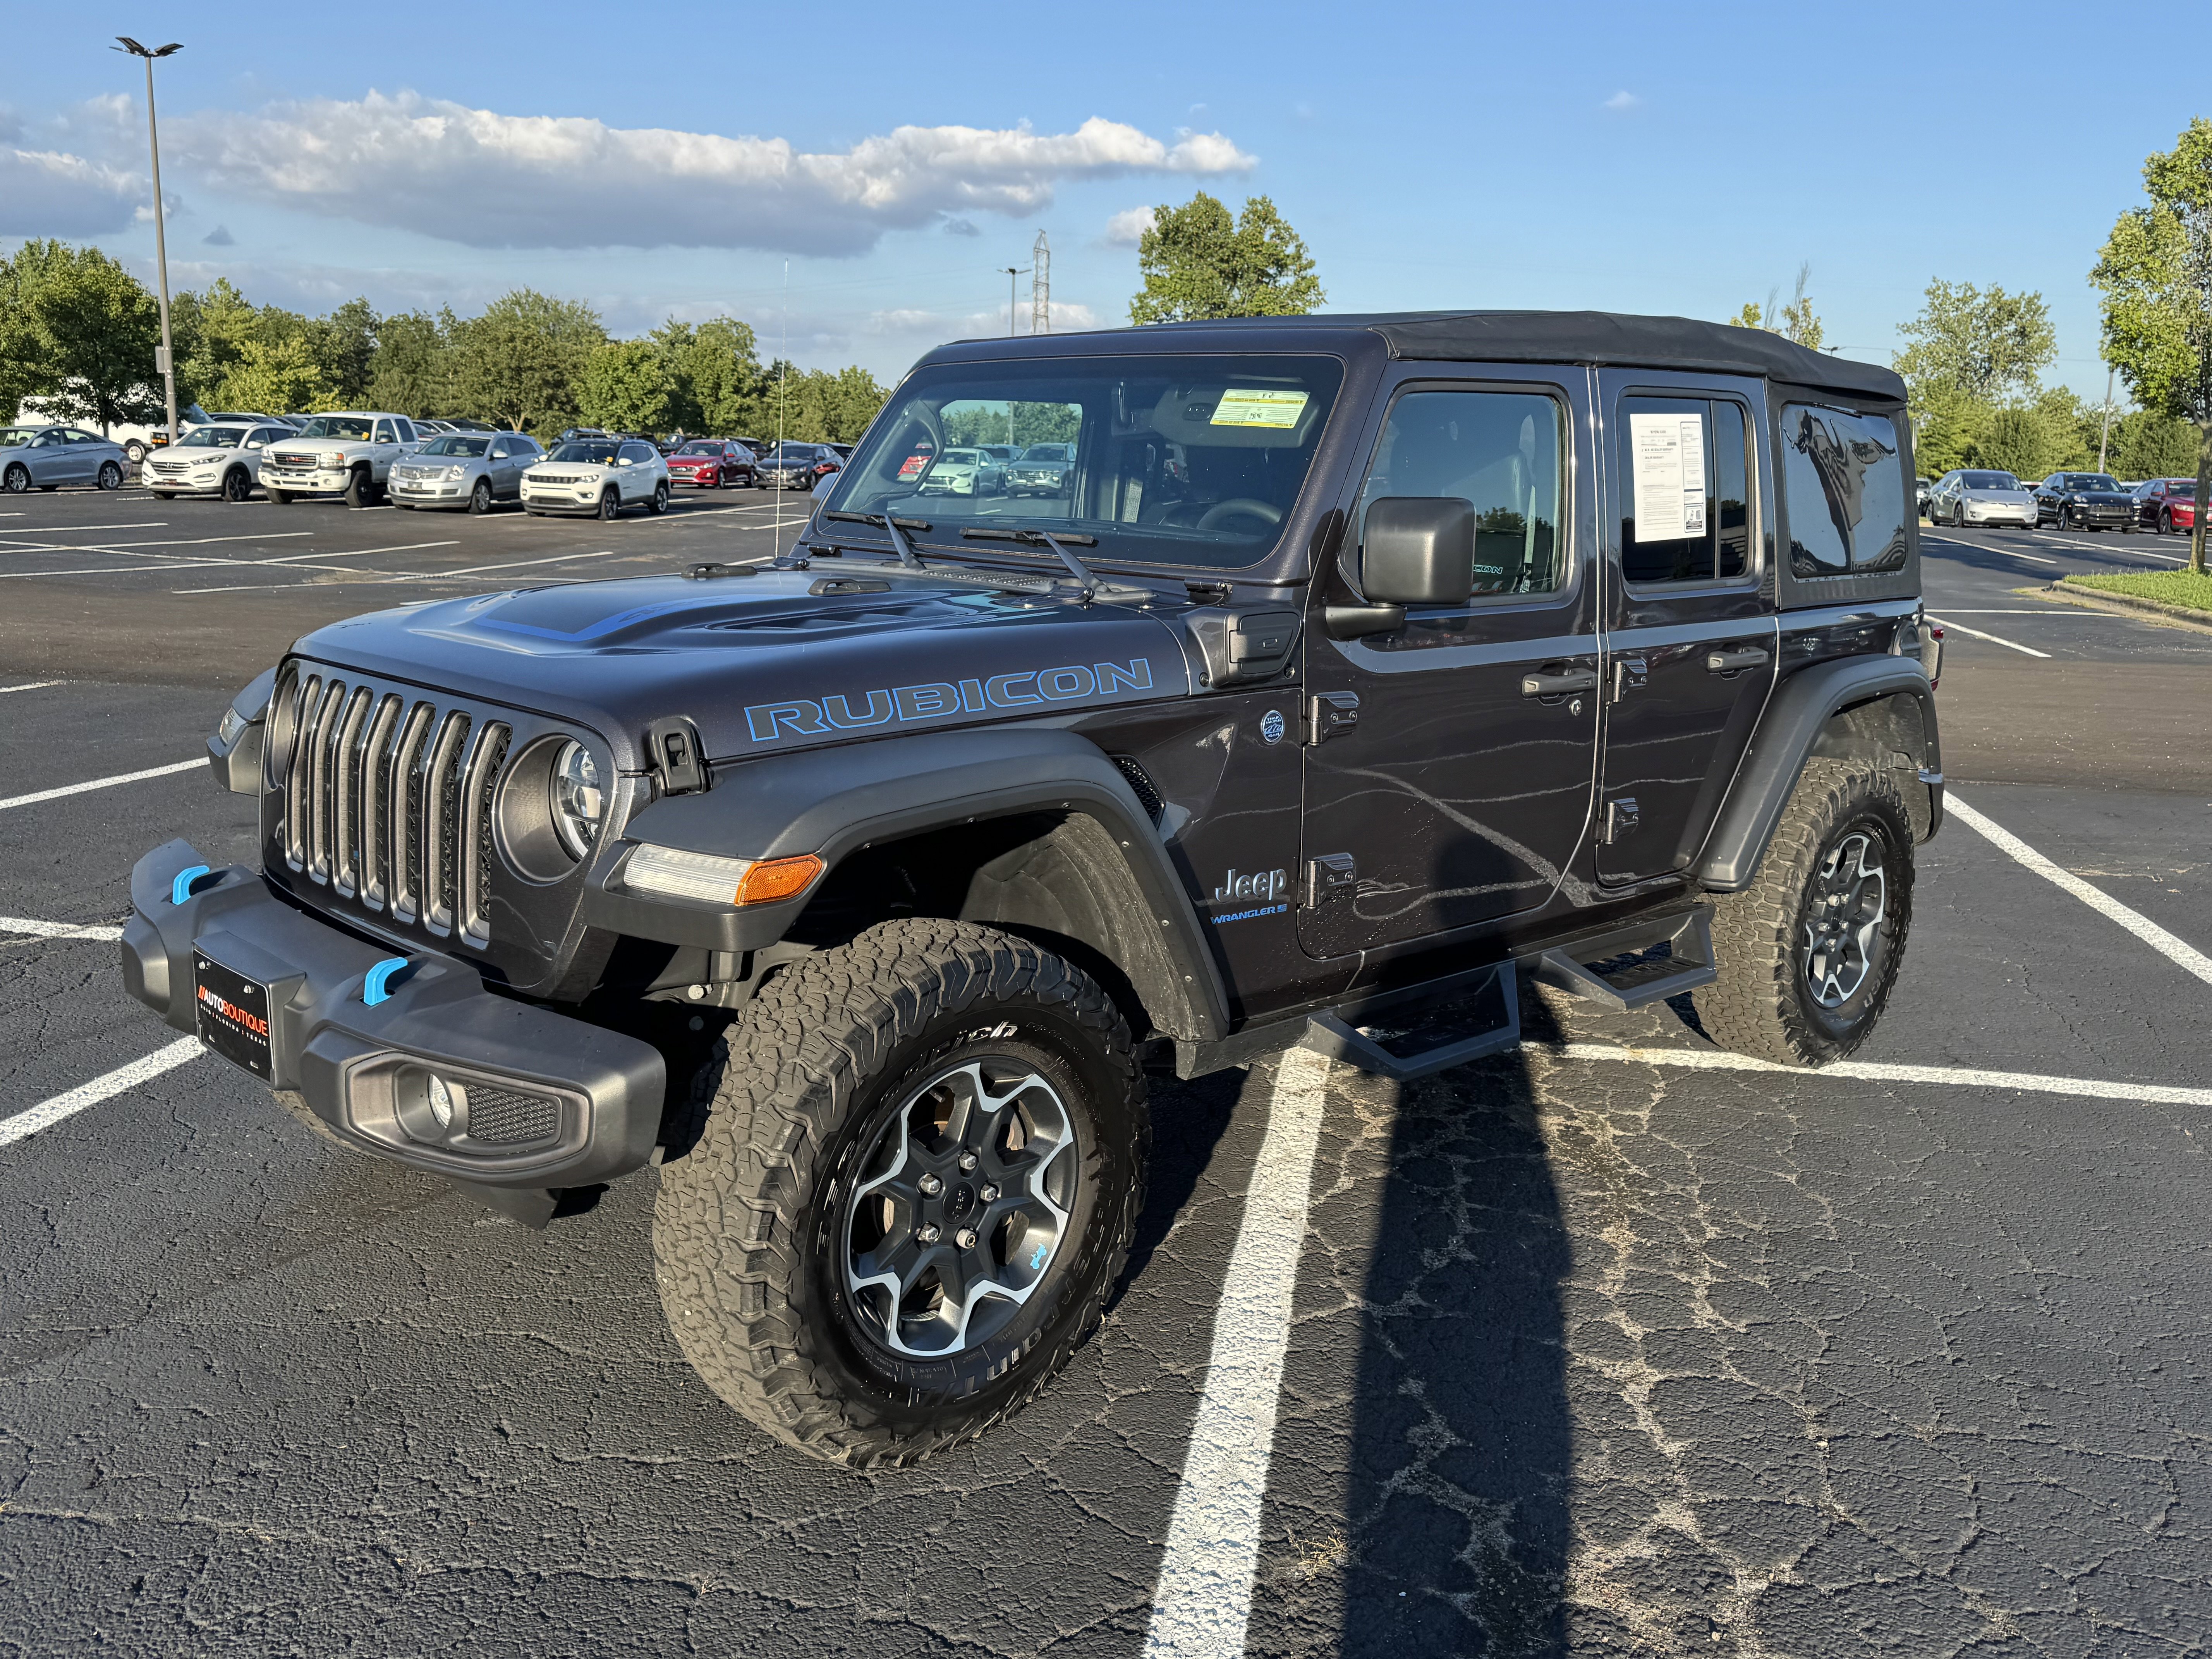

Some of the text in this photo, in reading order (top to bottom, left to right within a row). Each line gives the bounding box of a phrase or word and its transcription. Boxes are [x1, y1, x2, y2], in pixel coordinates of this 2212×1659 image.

[744, 658, 1153, 742] RUBICON
[1215, 869, 1287, 902] Jeep
[1210, 906, 1276, 924] WRANGLER
[215, 1014, 239, 1032] FLORIDA
